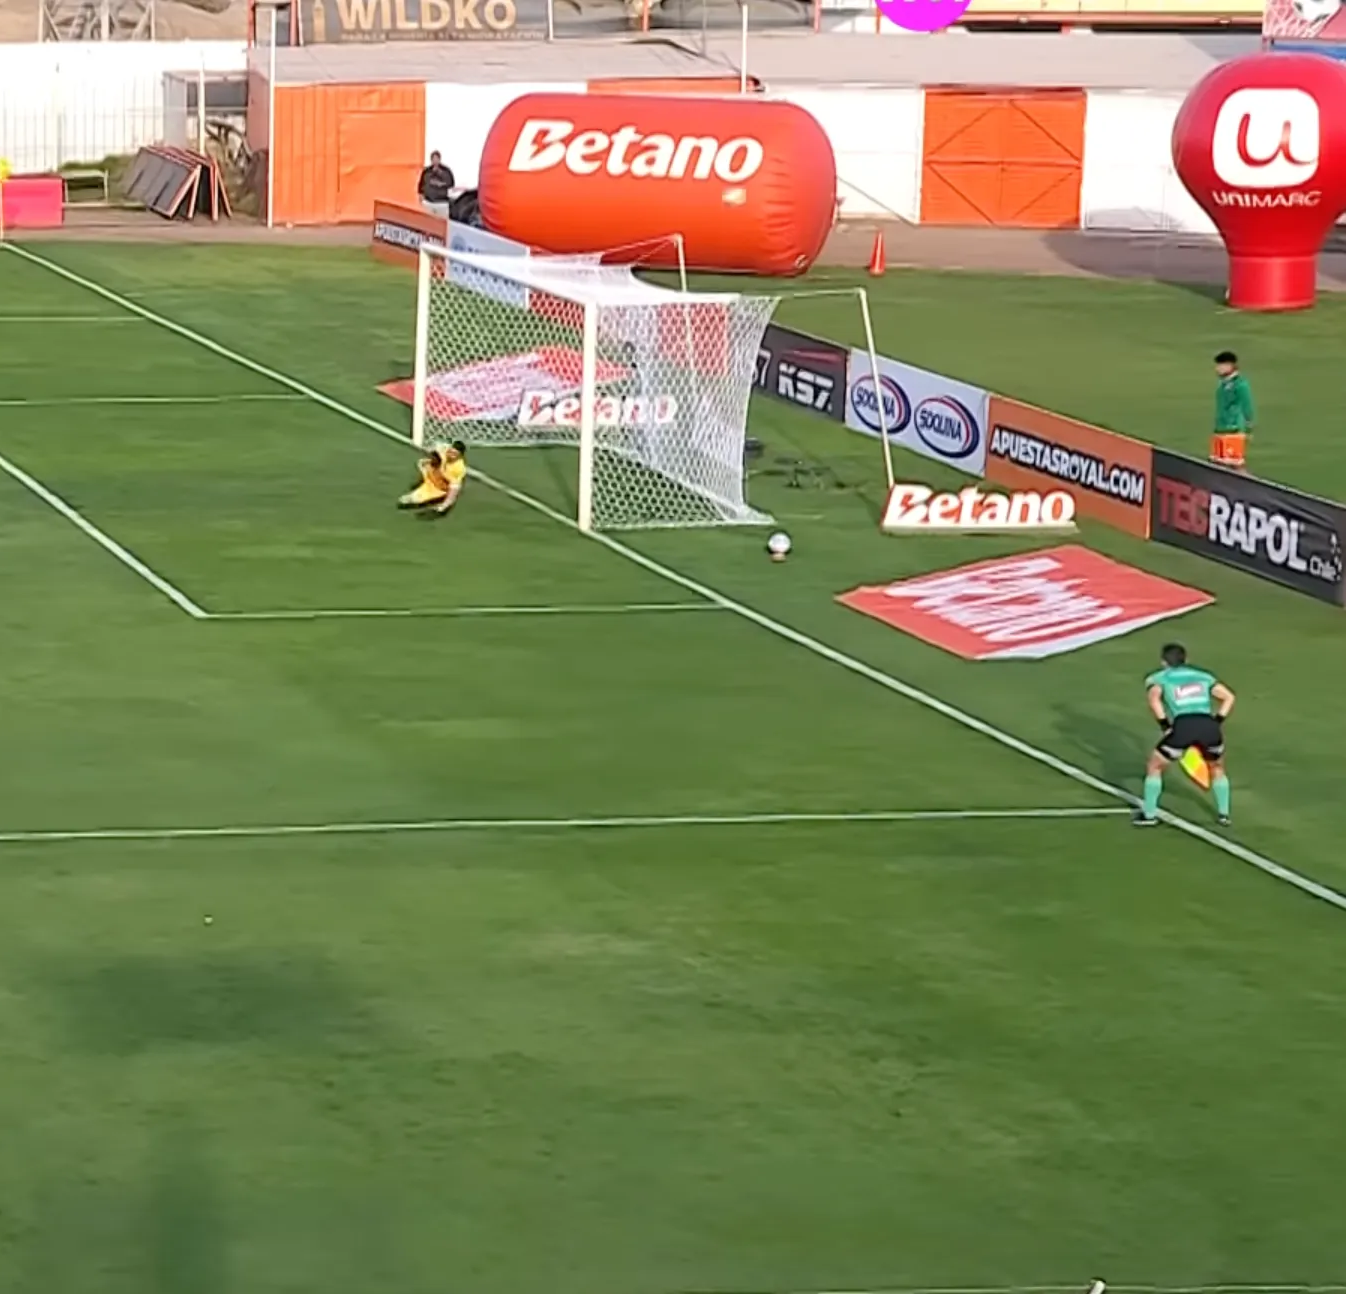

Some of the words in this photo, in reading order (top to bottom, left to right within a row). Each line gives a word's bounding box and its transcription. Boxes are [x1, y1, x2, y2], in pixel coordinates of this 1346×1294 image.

[337, 0, 517, 30] WILDKO
[508, 118, 764, 183] Betano
[919, 408, 962, 442] SOQUINA
[990, 428, 1145, 502] APUESTASROYAL.COM
[883, 484, 1076, 526] Betano
